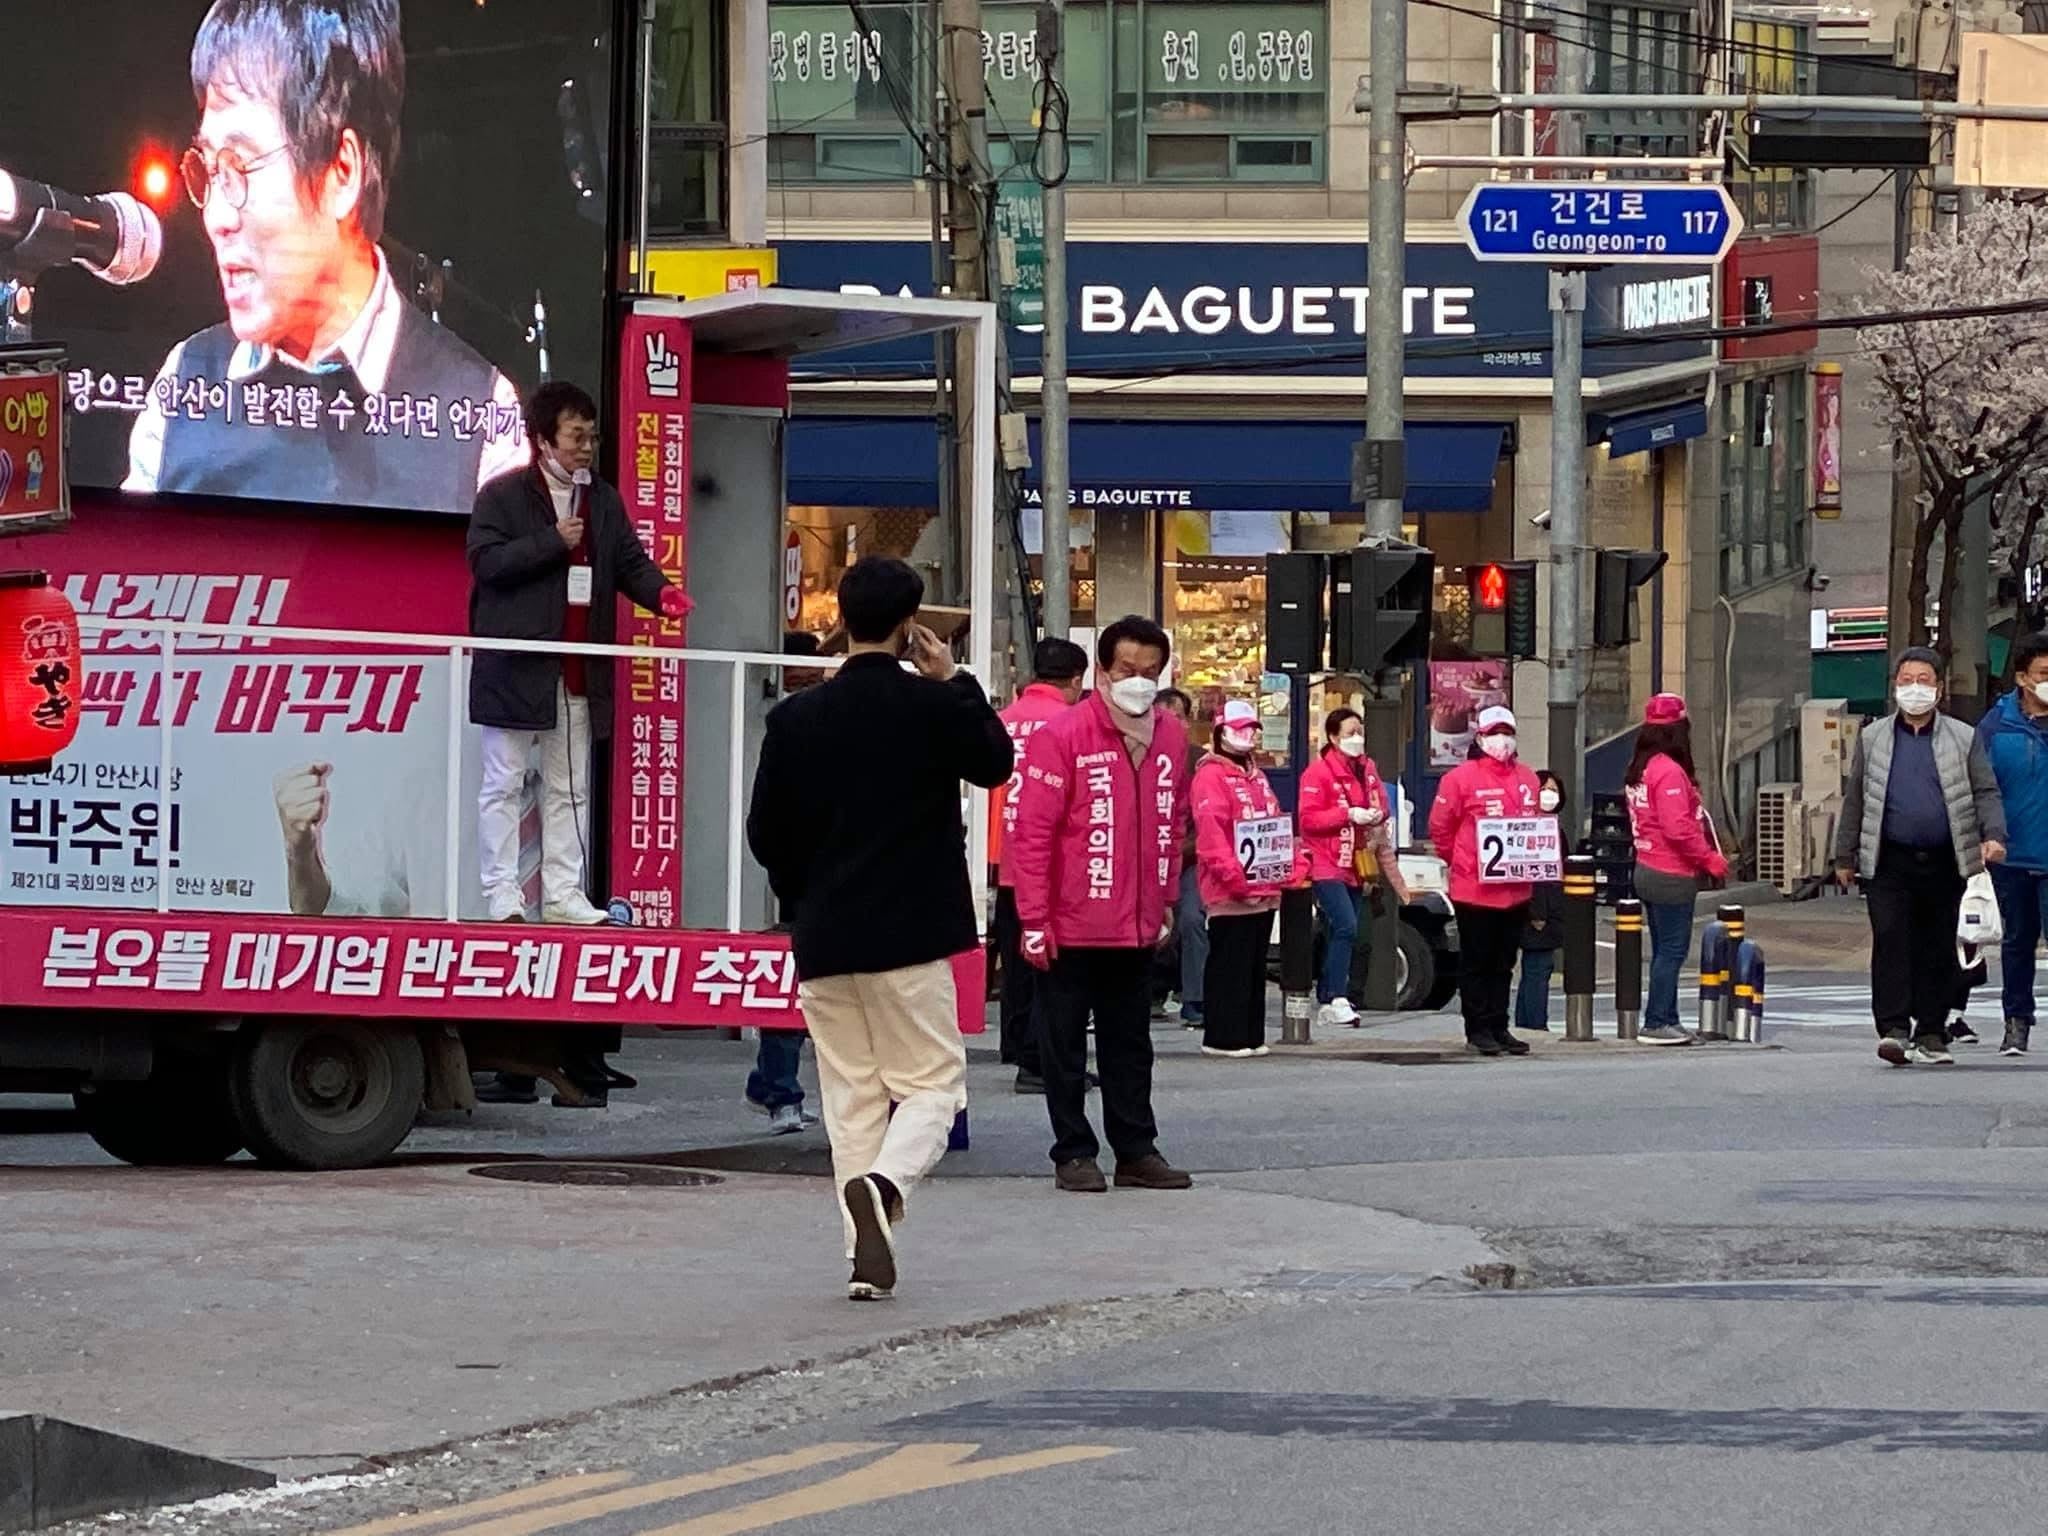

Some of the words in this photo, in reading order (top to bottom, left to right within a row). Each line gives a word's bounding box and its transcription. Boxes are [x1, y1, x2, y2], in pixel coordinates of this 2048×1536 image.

[1162, 31, 1199, 82] 휴진
[1482, 210, 1518, 232] 121
[1551, 193, 1647, 224] 건건로
[1682, 211, 1719, 234] 117
[1532, 230, 1667, 254] Geongeon-ro
[1081, 286, 1476, 334] BAGUETTE
[67, 369, 147, 412] 랑으로
[156, 376, 232, 423] 안산이
[243, 383, 322, 428] 발전할
[327, 389, 356, 431] 수
[364, 393, 439, 437] 있다면
[635, 413, 660, 506] 전철로
[664, 414, 684, 522] 국회의원
[1082, 490, 1191, 505] BAGUETTE
[214, 664, 424, 733] 바꾸자
[1156, 754, 1173, 787] 2
[1519, 784, 1537, 806] 2
[630, 715, 653, 877] 하겠습니다!
[11, 799, 180, 868] 박주원
[1087, 766, 1114, 887] 국회의원
[1240, 838, 1256, 880] 2
[1483, 835, 1506, 877] 2
[11, 872, 60, 890] 제21대
[65, 874, 125, 893] 국회의원
[176, 877, 205, 895] 안산
[43, 927, 211, 992] 본오뜰
[222, 932, 390, 996] 대기업
[398, 938, 562, 999] 반도체
[572, 944, 681, 1003] 단지
